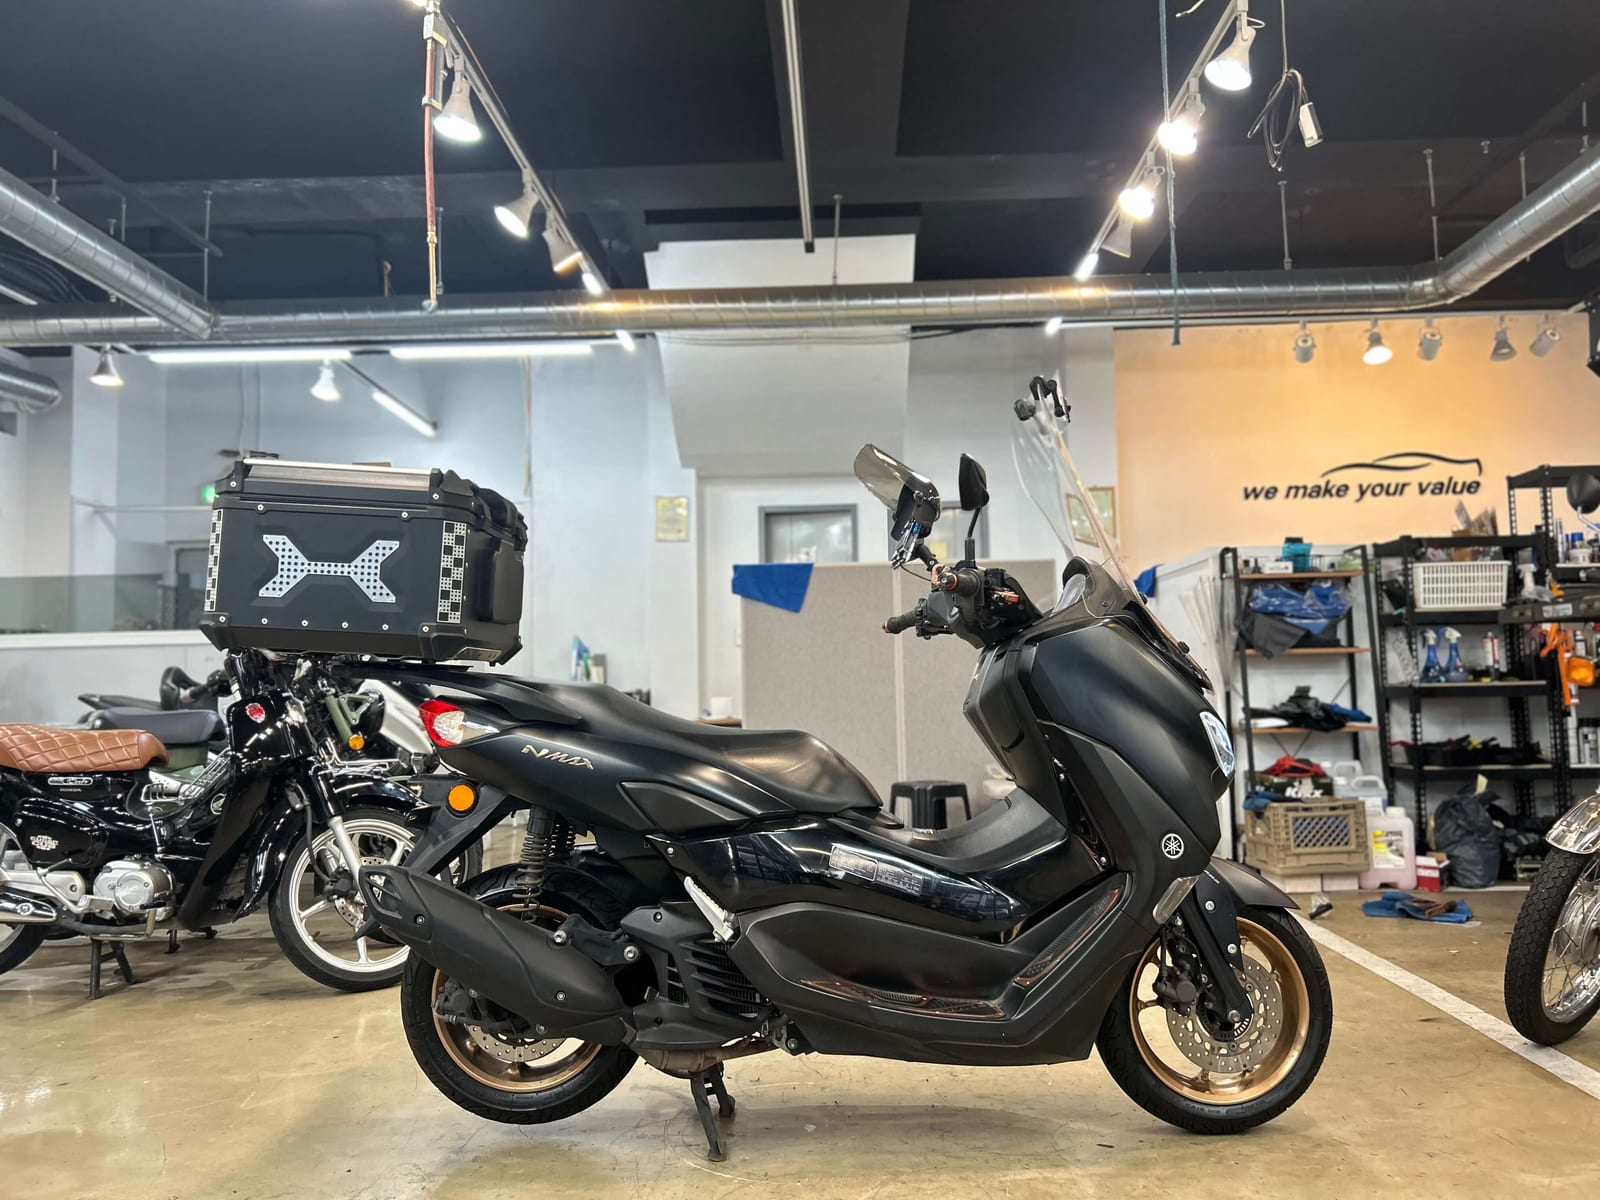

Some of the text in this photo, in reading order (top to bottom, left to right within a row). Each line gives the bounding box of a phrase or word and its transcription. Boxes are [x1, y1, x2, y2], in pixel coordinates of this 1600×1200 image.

[1243, 476, 1481, 503] we make your value
[521, 744, 594, 770] NMAX
